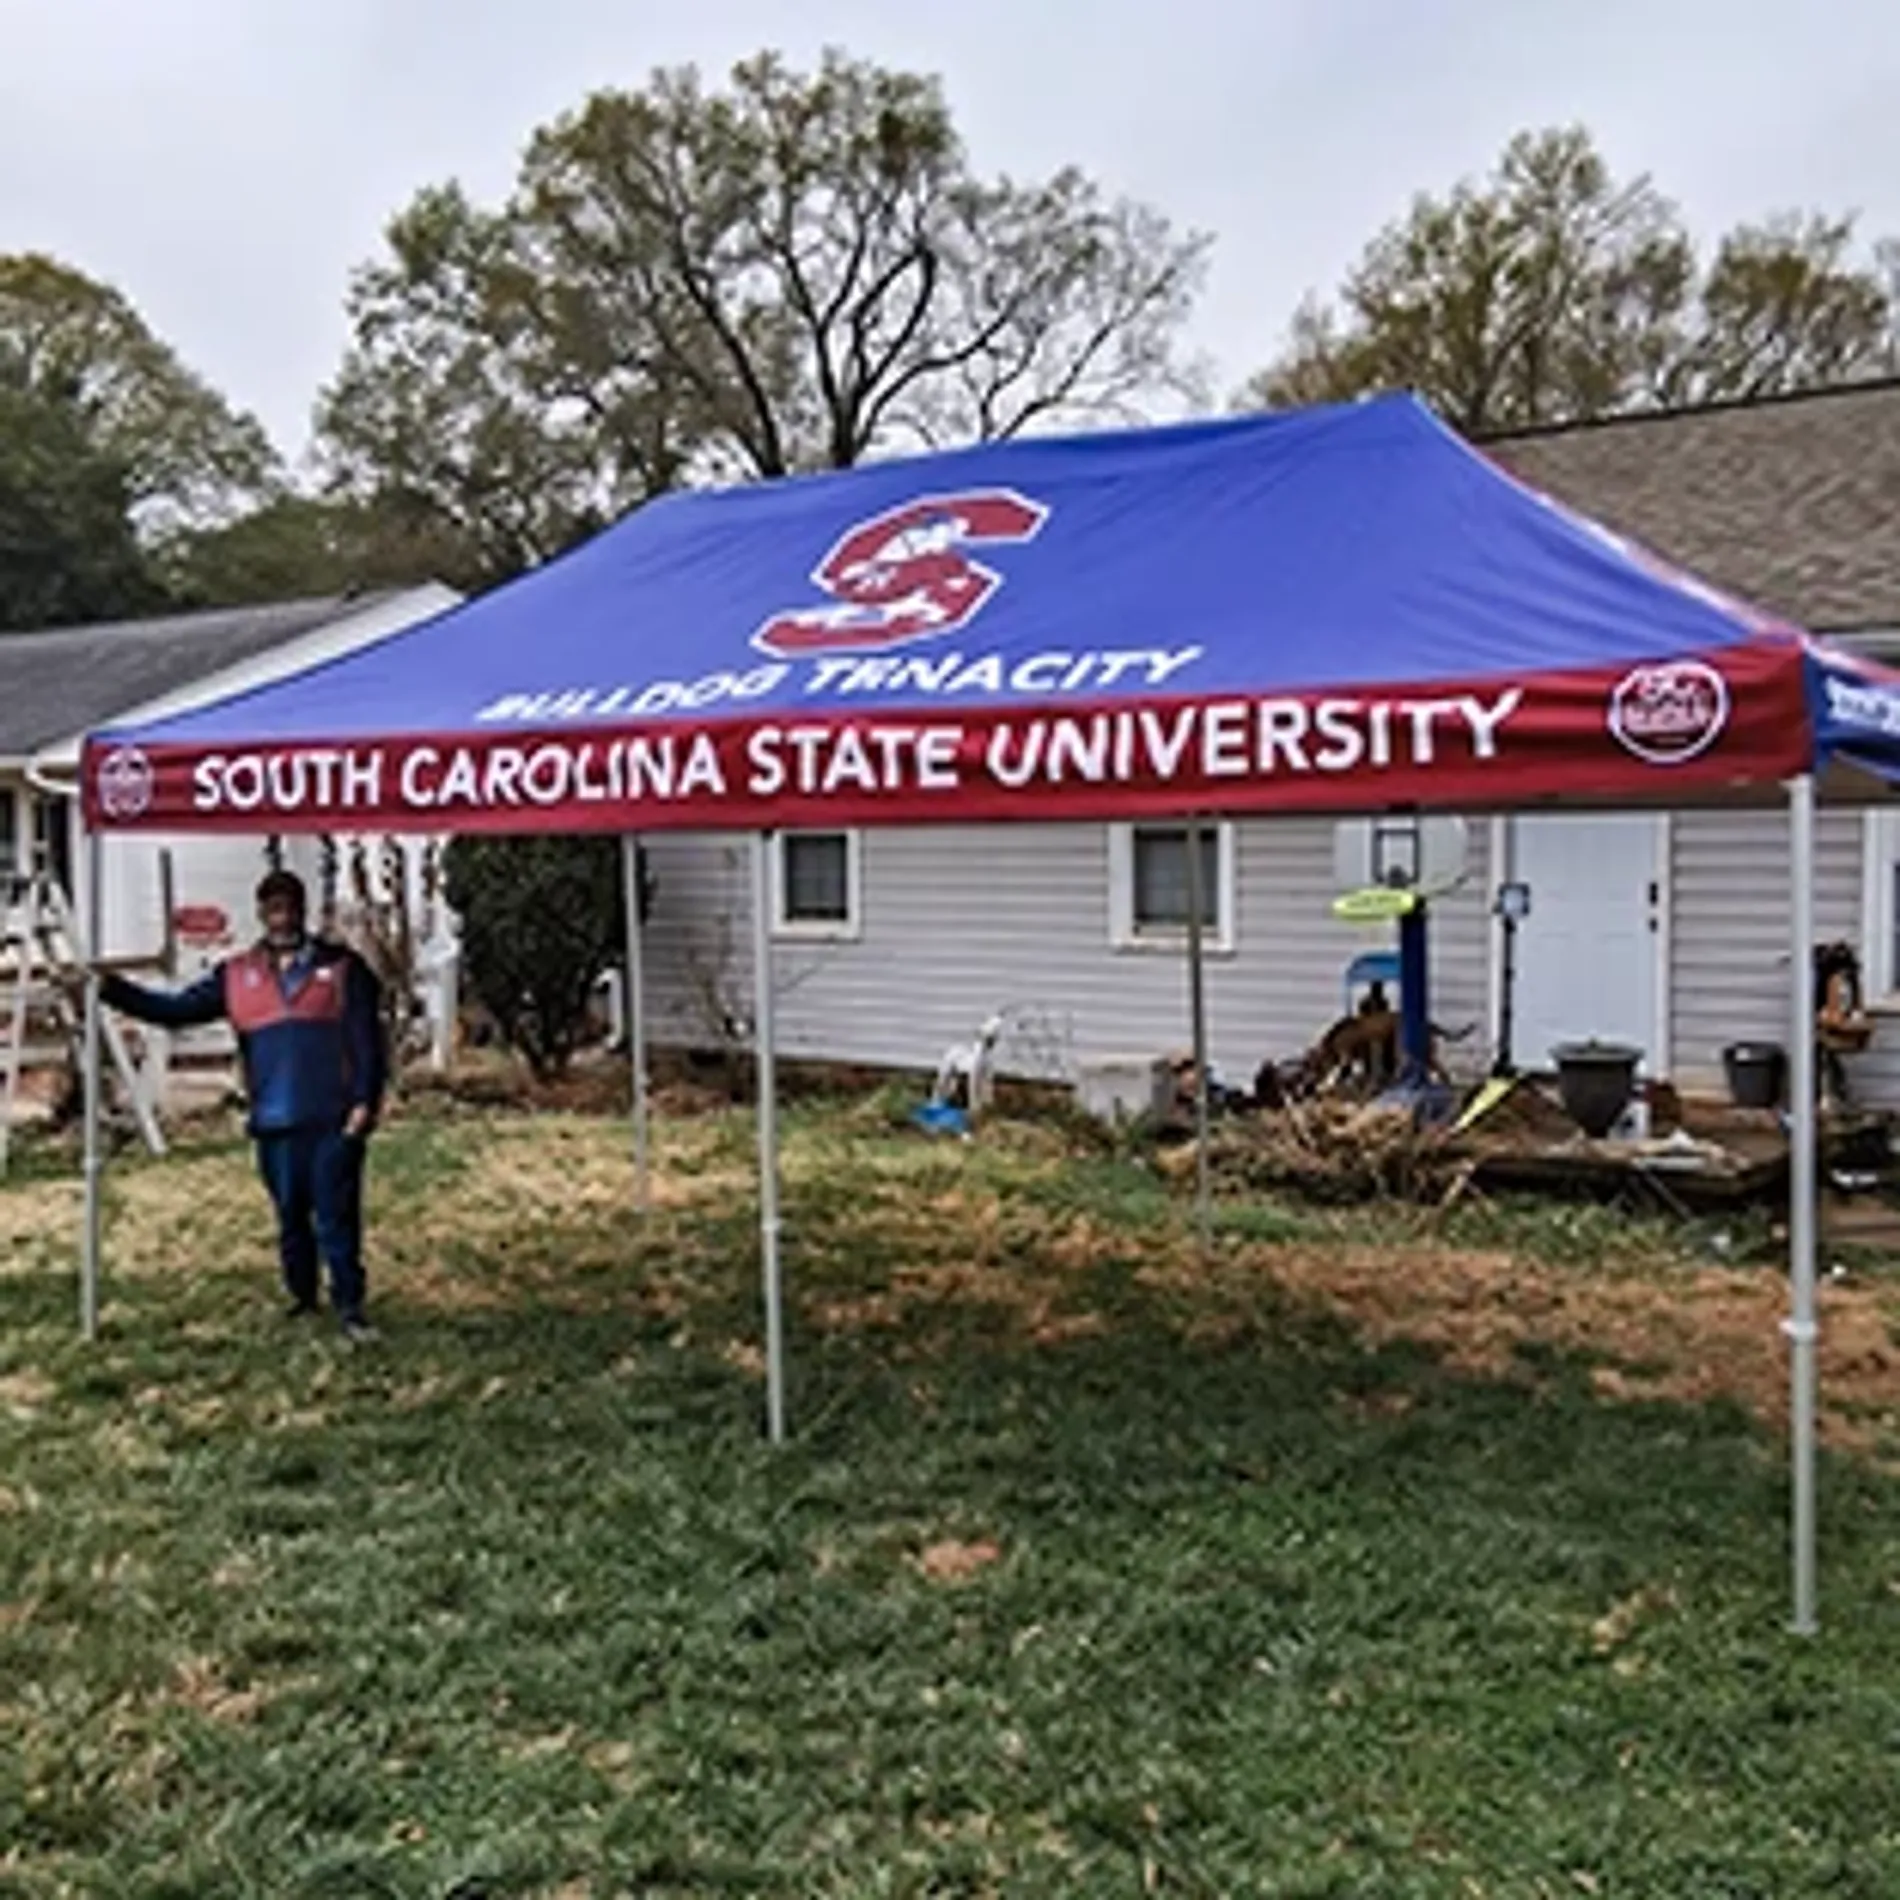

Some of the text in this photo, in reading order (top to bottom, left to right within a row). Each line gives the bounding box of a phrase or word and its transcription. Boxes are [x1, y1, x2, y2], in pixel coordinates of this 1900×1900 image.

[193, 750, 382, 809] SOUTH
[402, 735, 724, 807] CAROLINA
[748, 724, 960, 794] STATE
[985, 690, 1522, 785] UNIVERSITY
